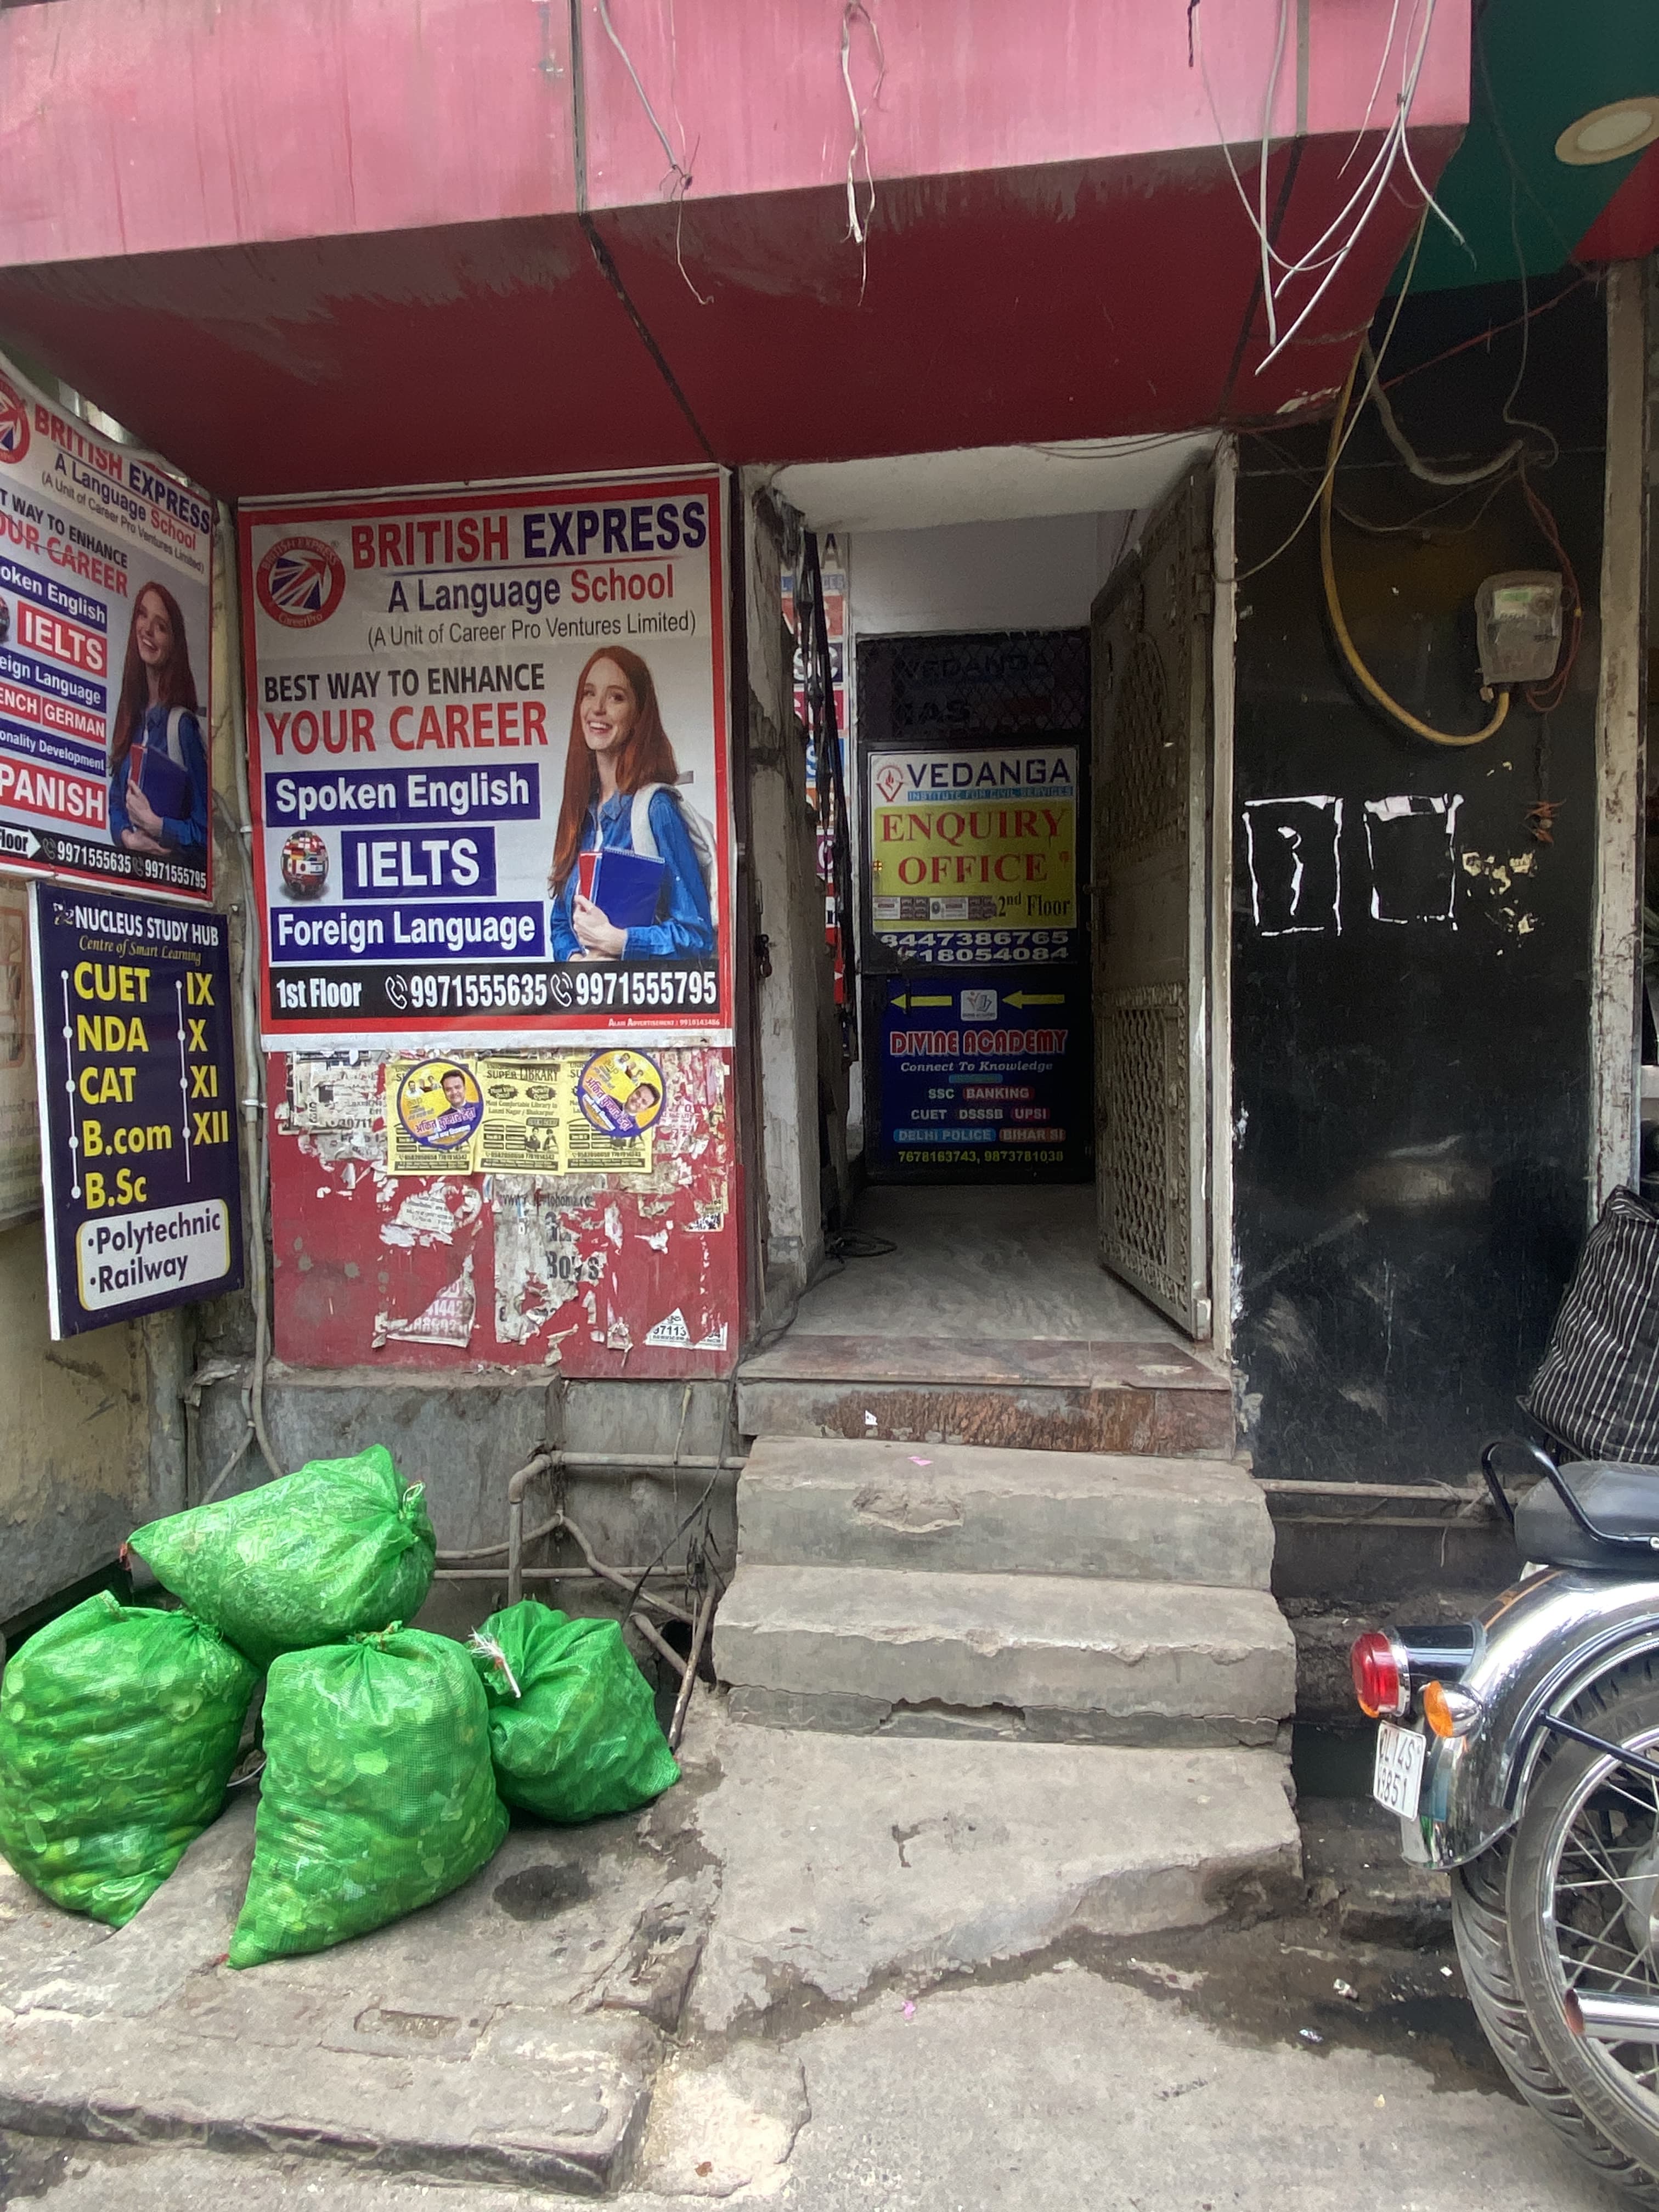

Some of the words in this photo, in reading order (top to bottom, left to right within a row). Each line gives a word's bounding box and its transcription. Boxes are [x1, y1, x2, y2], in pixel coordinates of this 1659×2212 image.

[35, 403, 122, 481] BRITISH
[129, 462, 210, 534] EXPRESS
[55, 453, 66, 475] A
[72, 460, 146, 520] Language
[150, 508, 195, 550] School
[55, 477, 75, 498] Unit
[89, 498, 118, 521] Career
[121, 516, 136, 534] Pro
[138, 524, 172, 554] Ventures
[12, 494, 44, 524] WAY
[47, 514, 65, 535] TO
[69, 525, 128, 568] ENHANCE
[351, 515, 509, 569] BRITISH
[523, 502, 707, 559] EXPRESS
[47, 537, 128, 597] CAREER
[262, 539, 296, 570] BRITISH
[0, 566, 42, 596] oken
[47, 582, 106, 624] English
[387, 580, 409, 613] A
[419, 574, 561, 617] Language
[571, 565, 674, 604] School
[25, 610, 103, 670] IELTS
[368, 627, 387, 651] (A
[391, 626, 424, 646] Unit
[428, 624, 444, 644] of
[449, 623, 504, 643] Career
[511, 619, 540, 639] Pro
[545, 616, 621, 638] Ventures
[627, 610, 696, 635] Limited)
[0, 654, 31, 679] eign
[35, 665, 101, 705] Language
[264, 674, 320, 703] BEST
[328, 671, 380, 699] WAY
[387, 668, 419, 697] TO
[428, 663, 545, 695] ENHANCE
[44, 703, 105, 738] GERMAN
[264, 707, 375, 755] YOUR
[390, 701, 549, 751] CAREER
[0, 730, 36, 753] onality
[40, 740, 104, 770] Development
[0, 764, 103, 821] PANISH
[907, 758, 1071, 788] VEDANGA
[276, 776, 396, 820] Spoken
[408, 774, 529, 816] English
[909, 791, 960, 801] INSTITUTE
[881, 809, 1069, 847] ENQUIRY
[58, 841, 131, 874] 9971555635
[144, 860, 206, 889] 9971555795
[357, 839, 479, 887] IELTS
[898, 853, 1047, 885] OFFICE
[75, 906, 143, 937] NUCLEUS
[146, 917, 188, 943] STUDY
[192, 924, 219, 946] HUB
[1027, 895, 1071, 916] Floor
[79, 935, 113, 952] Centre
[116, 939, 129, 958] of
[129, 941, 158, 957] Smart
[162, 946, 201, 966] Learning
[278, 912, 383, 953] Foreign
[393, 910, 535, 950] Language
[74, 962, 150, 1003] CUET
[187, 972, 215, 1006] IX
[276, 980, 309, 1008] 1st
[310, 980, 362, 1008] Floor
[410, 974, 546, 1008] 9971555635
[576, 972, 716, 1005] 9971555795
[77, 1015, 149, 1053] NDA
[188, 1018, 208, 1052] X
[890, 1031, 958, 1056] DIVINE
[963, 1029, 1068, 1055] ACADEMY
[79, 1066, 136, 1105] CAT
[190, 1064, 218, 1099] XI
[521, 1067, 558, 1082] LIBRARY
[901, 1062, 953, 1072] Connect
[959, 1062, 975, 1071] To
[979, 1060, 1053, 1072] Knowledge
[928, 1088, 955, 1099] SSC
[966, 1088, 1030, 1099] BANKING
[83, 1120, 172, 1158] B.com
[193, 1111, 229, 1146] XII
[899, 1129, 938, 1141] DELHI
[942, 1129, 992, 1141] POLICE
[1004, 1129, 1045, 1141] BIHAR
[911, 1109, 947, 1120] CUET
[85, 1169, 148, 1210] B.Sc
[97, 1207, 221, 1255] Polytechnic
[98, 1254, 188, 1293] Railway
